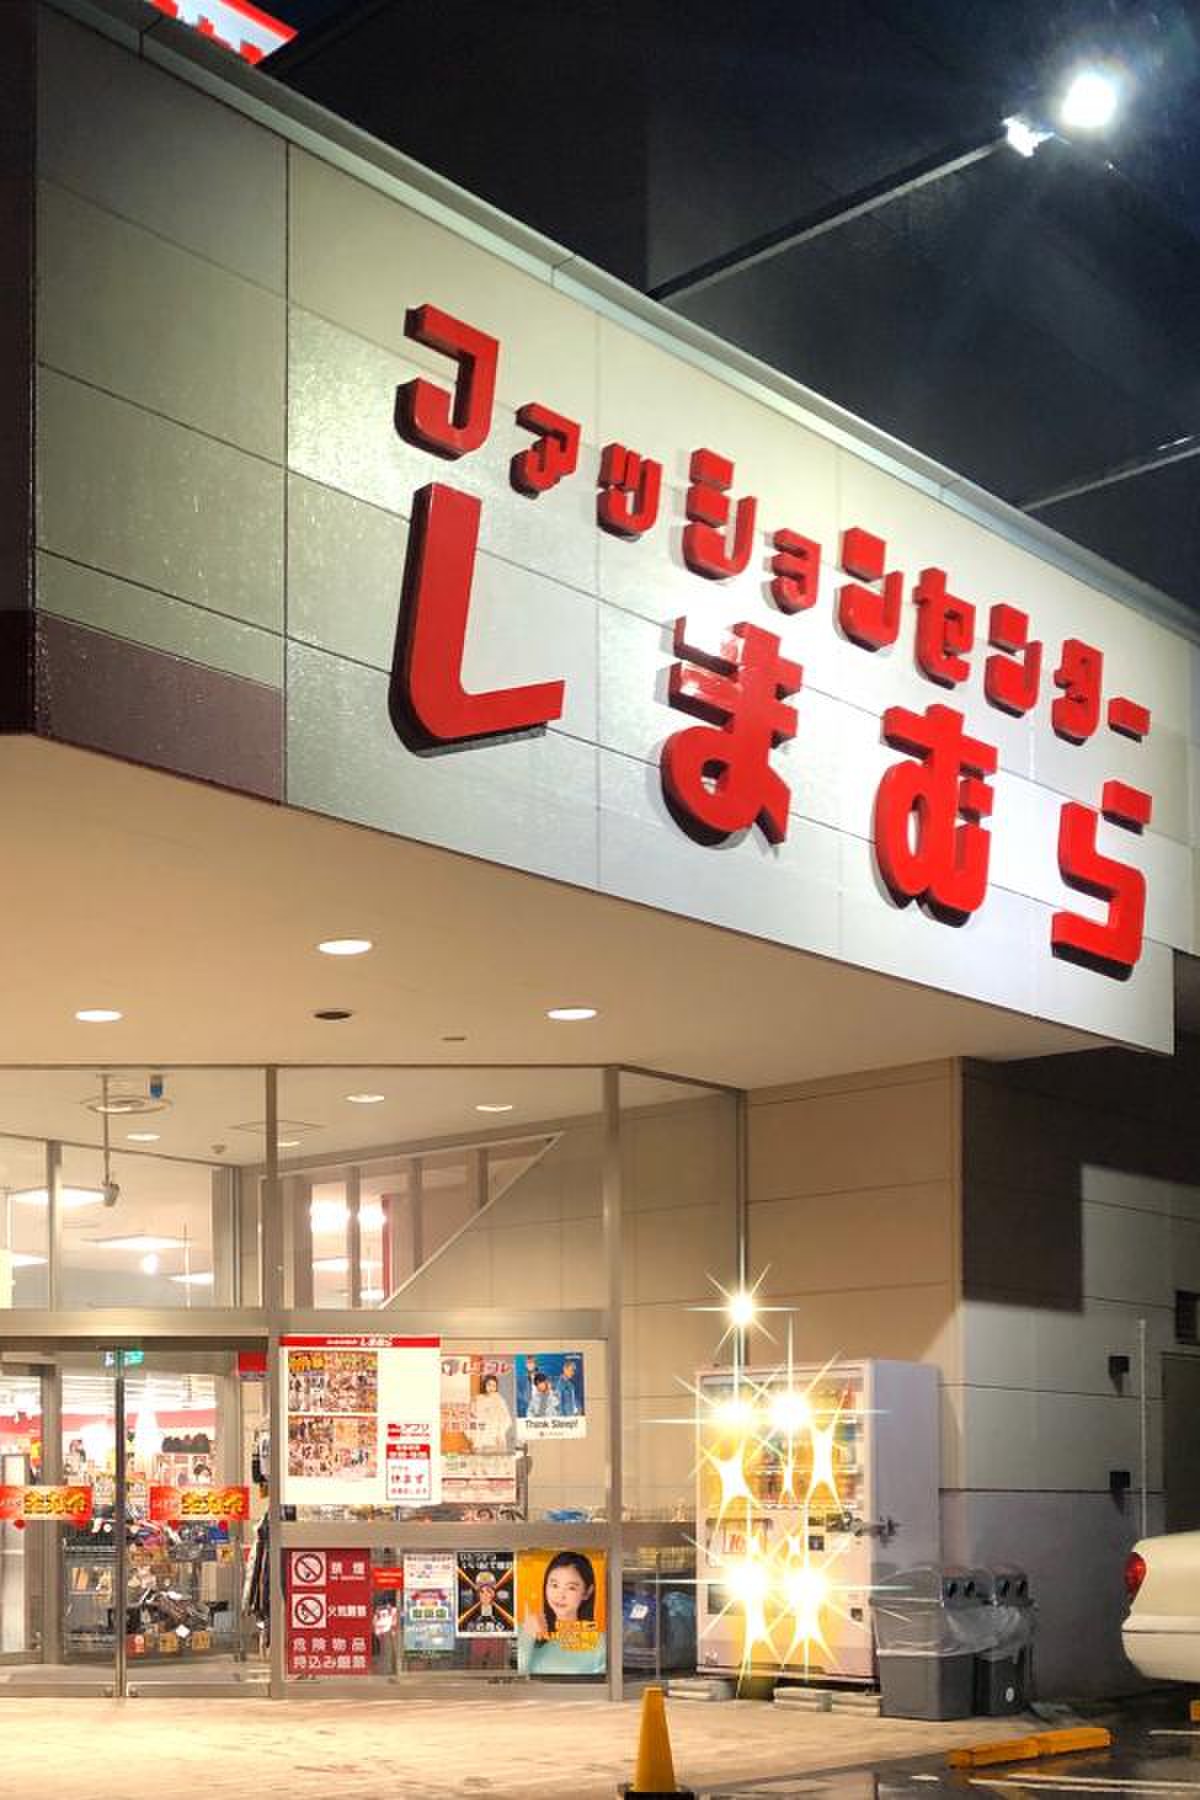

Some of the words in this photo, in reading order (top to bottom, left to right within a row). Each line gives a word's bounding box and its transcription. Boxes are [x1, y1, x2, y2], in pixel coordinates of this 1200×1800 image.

[392, 482, 1151, 980] しまむら
[396, 304, 1150, 744] ファッションセンター
